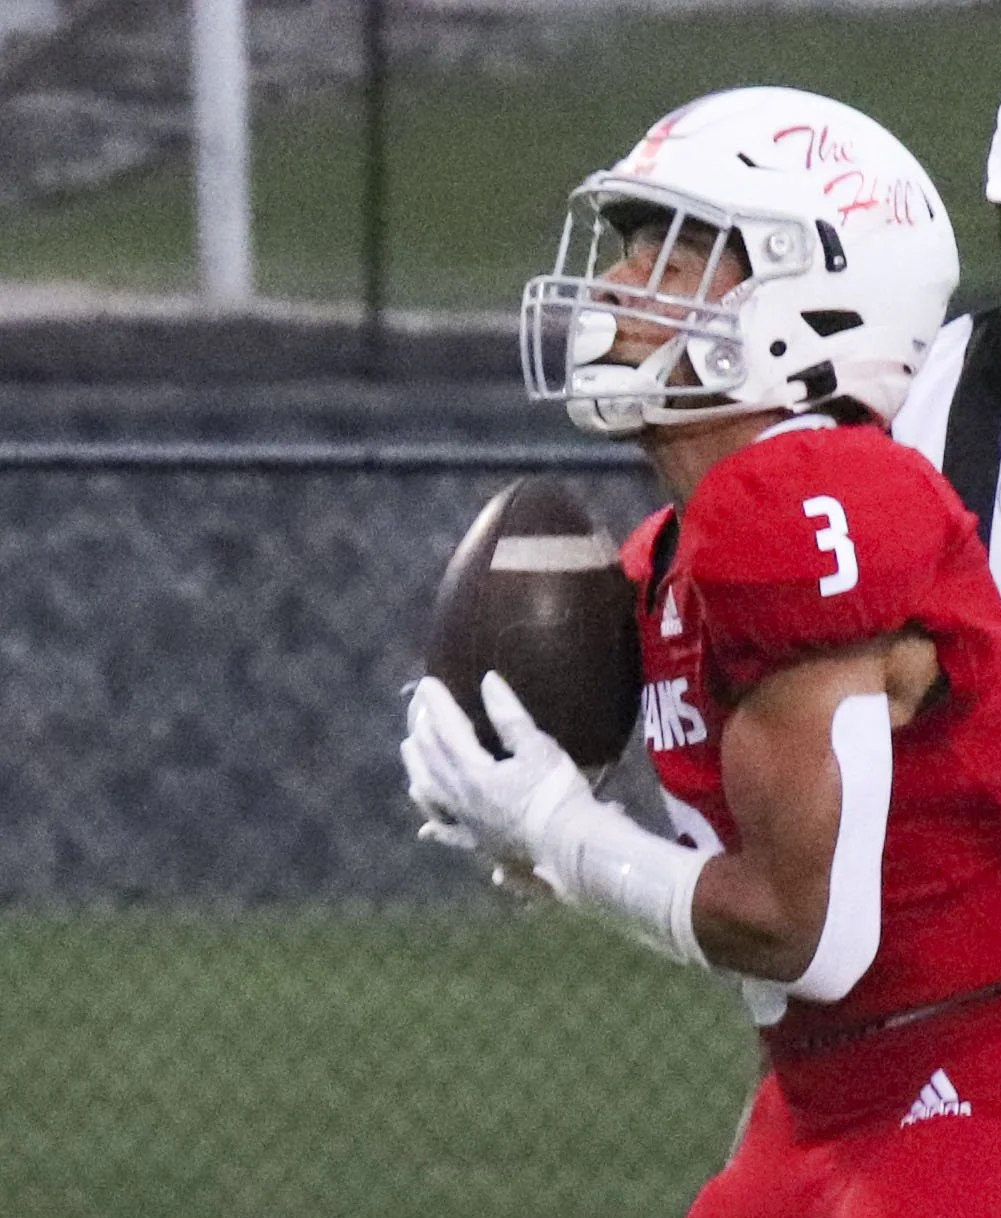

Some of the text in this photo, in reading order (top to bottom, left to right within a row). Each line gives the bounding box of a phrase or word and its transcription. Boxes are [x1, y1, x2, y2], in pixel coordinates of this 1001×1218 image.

[773, 125, 855, 169] The
[823, 171, 914, 227] Hill
[803, 495, 859, 598] 3
